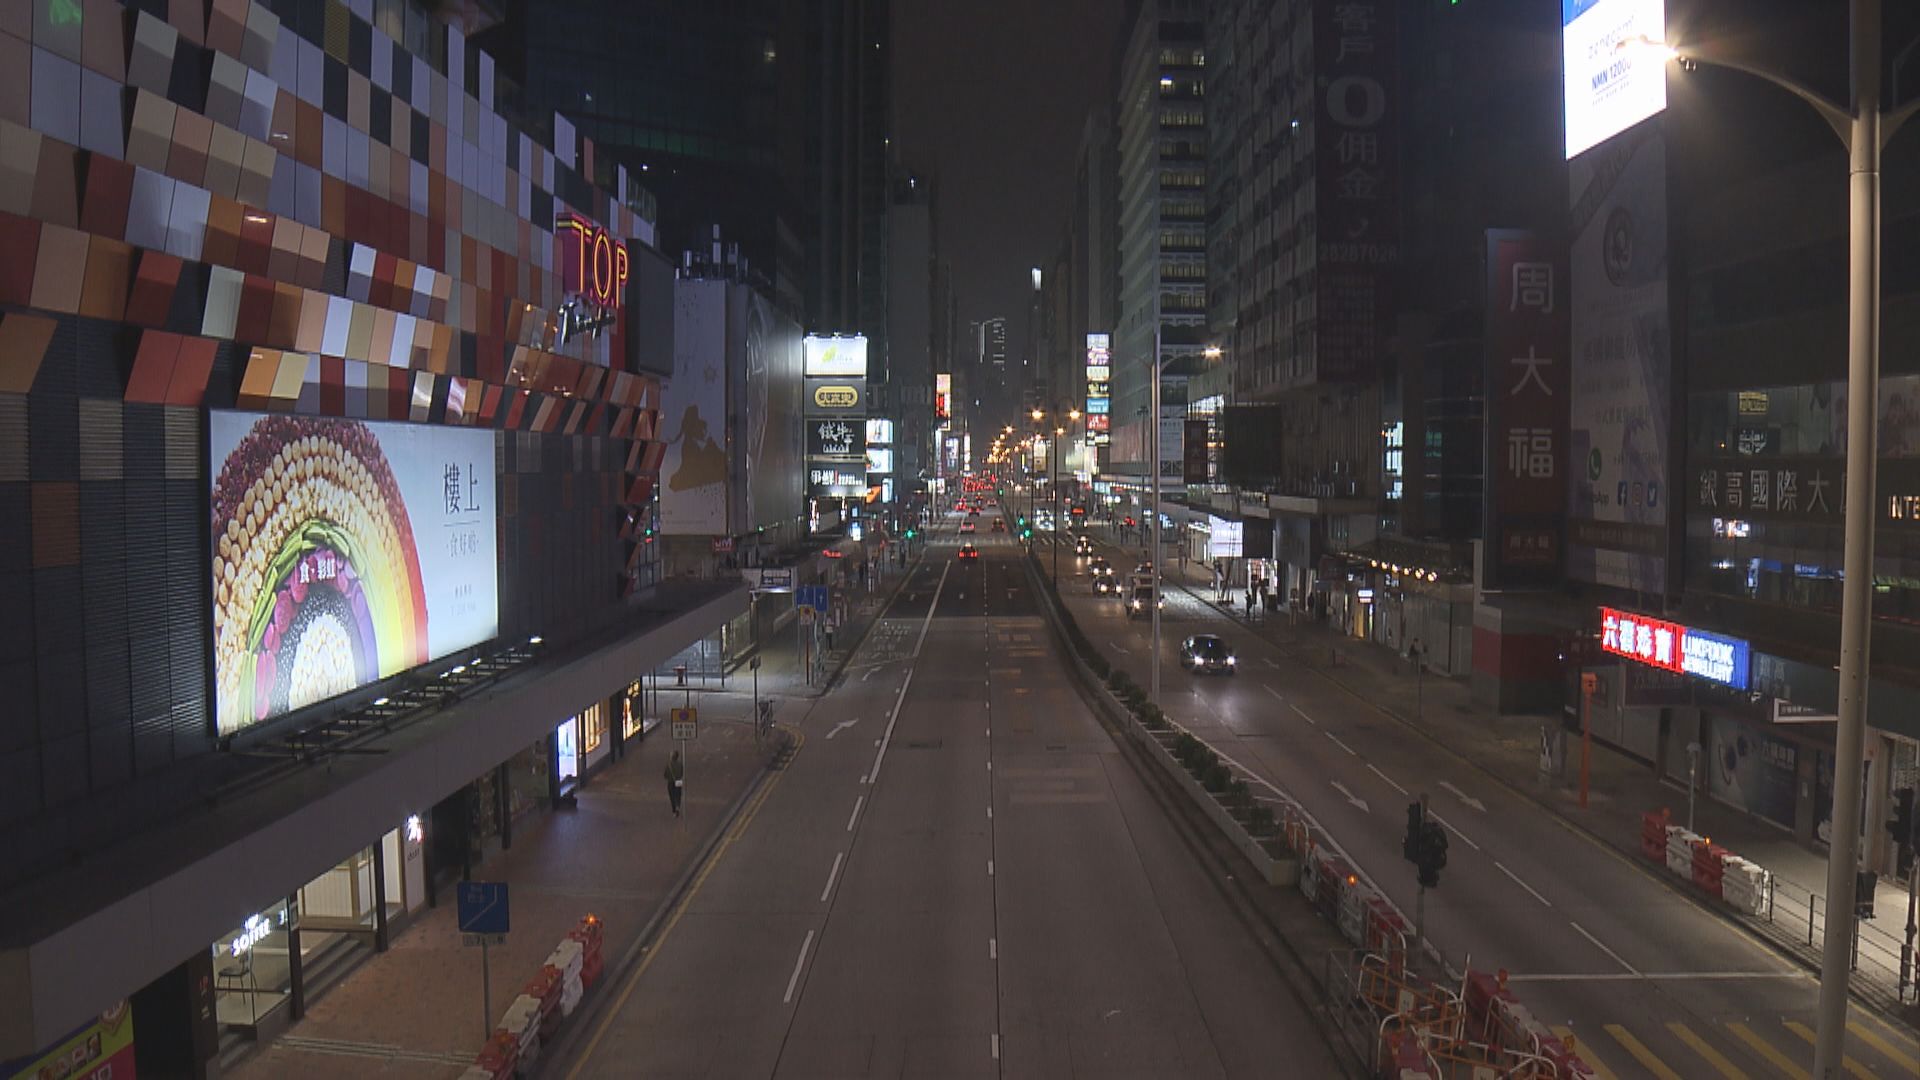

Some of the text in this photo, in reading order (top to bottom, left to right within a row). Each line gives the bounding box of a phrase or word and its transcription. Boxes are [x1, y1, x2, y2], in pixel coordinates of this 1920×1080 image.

[1591, 67, 1608, 91] NMN
[556, 213, 629, 310] TOP
[1508, 262, 1555, 480] 周大福
[443, 461, 480, 515] 樓上
